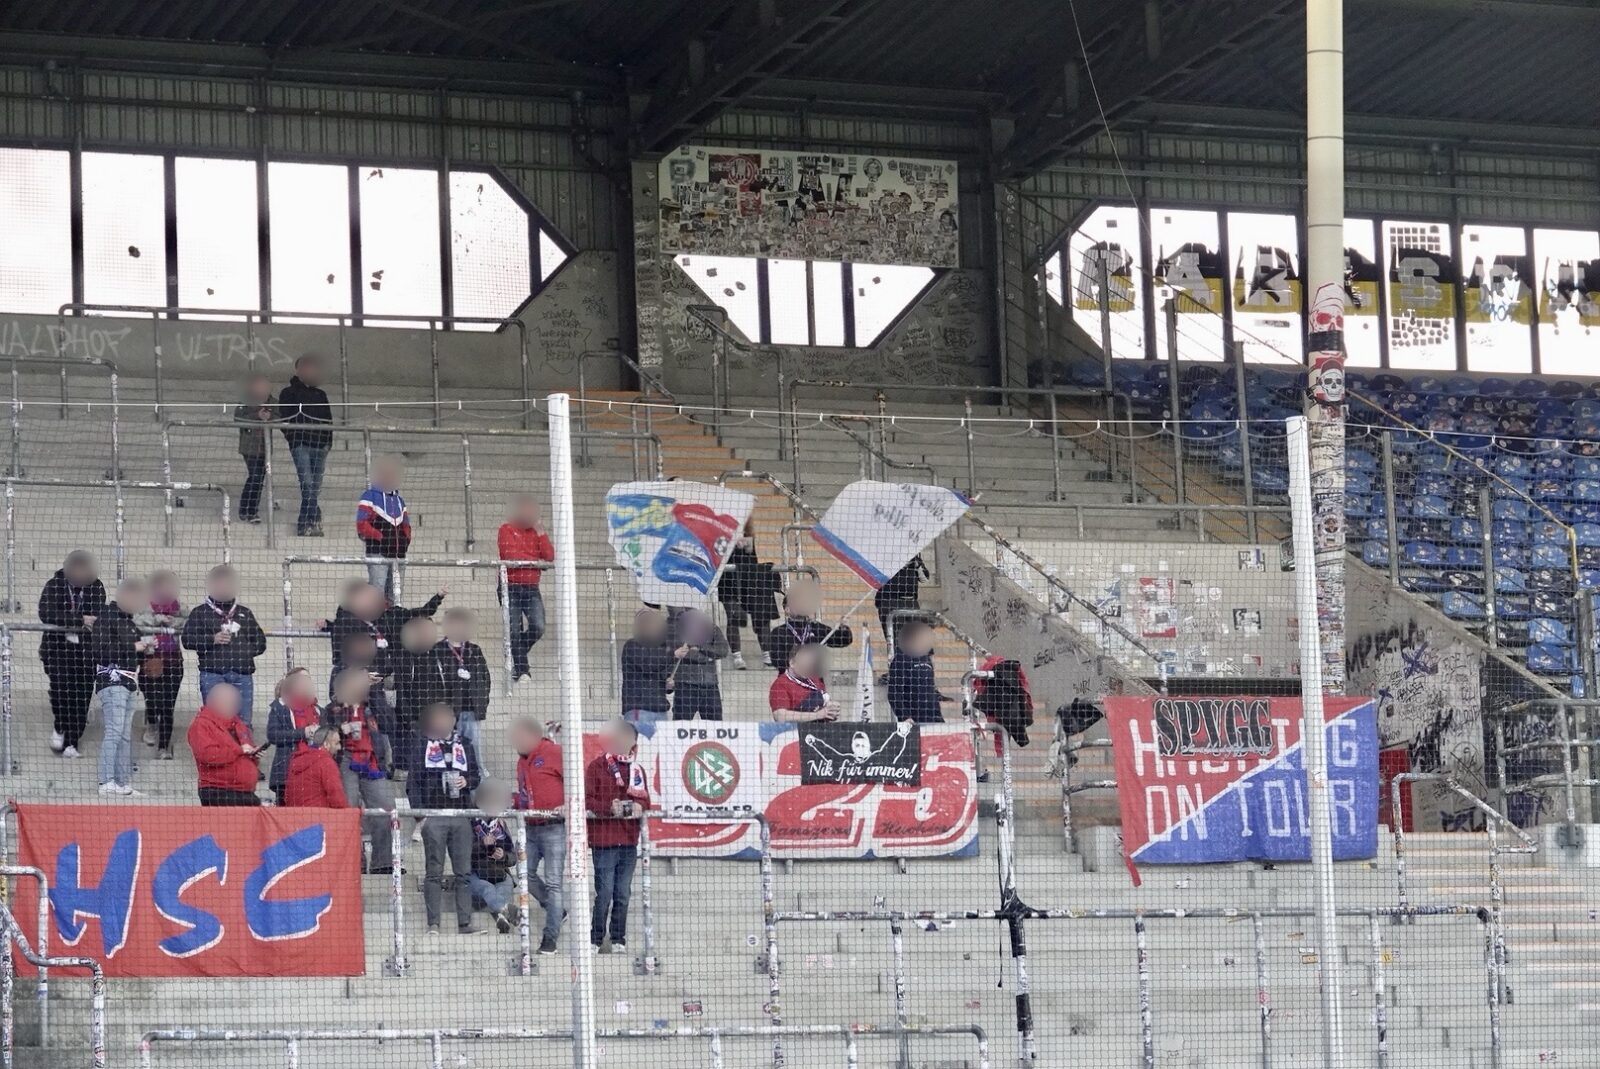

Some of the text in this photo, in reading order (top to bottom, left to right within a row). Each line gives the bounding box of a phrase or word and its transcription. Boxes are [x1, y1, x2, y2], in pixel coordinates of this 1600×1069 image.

[176, 332, 293, 367] ULTRAS
[677, 728, 738, 739] DFB DU
[807, 759, 918, 781] Nik für immer!
[1145, 782, 1209, 842] ON
[47, 823, 333, 959] HSC
